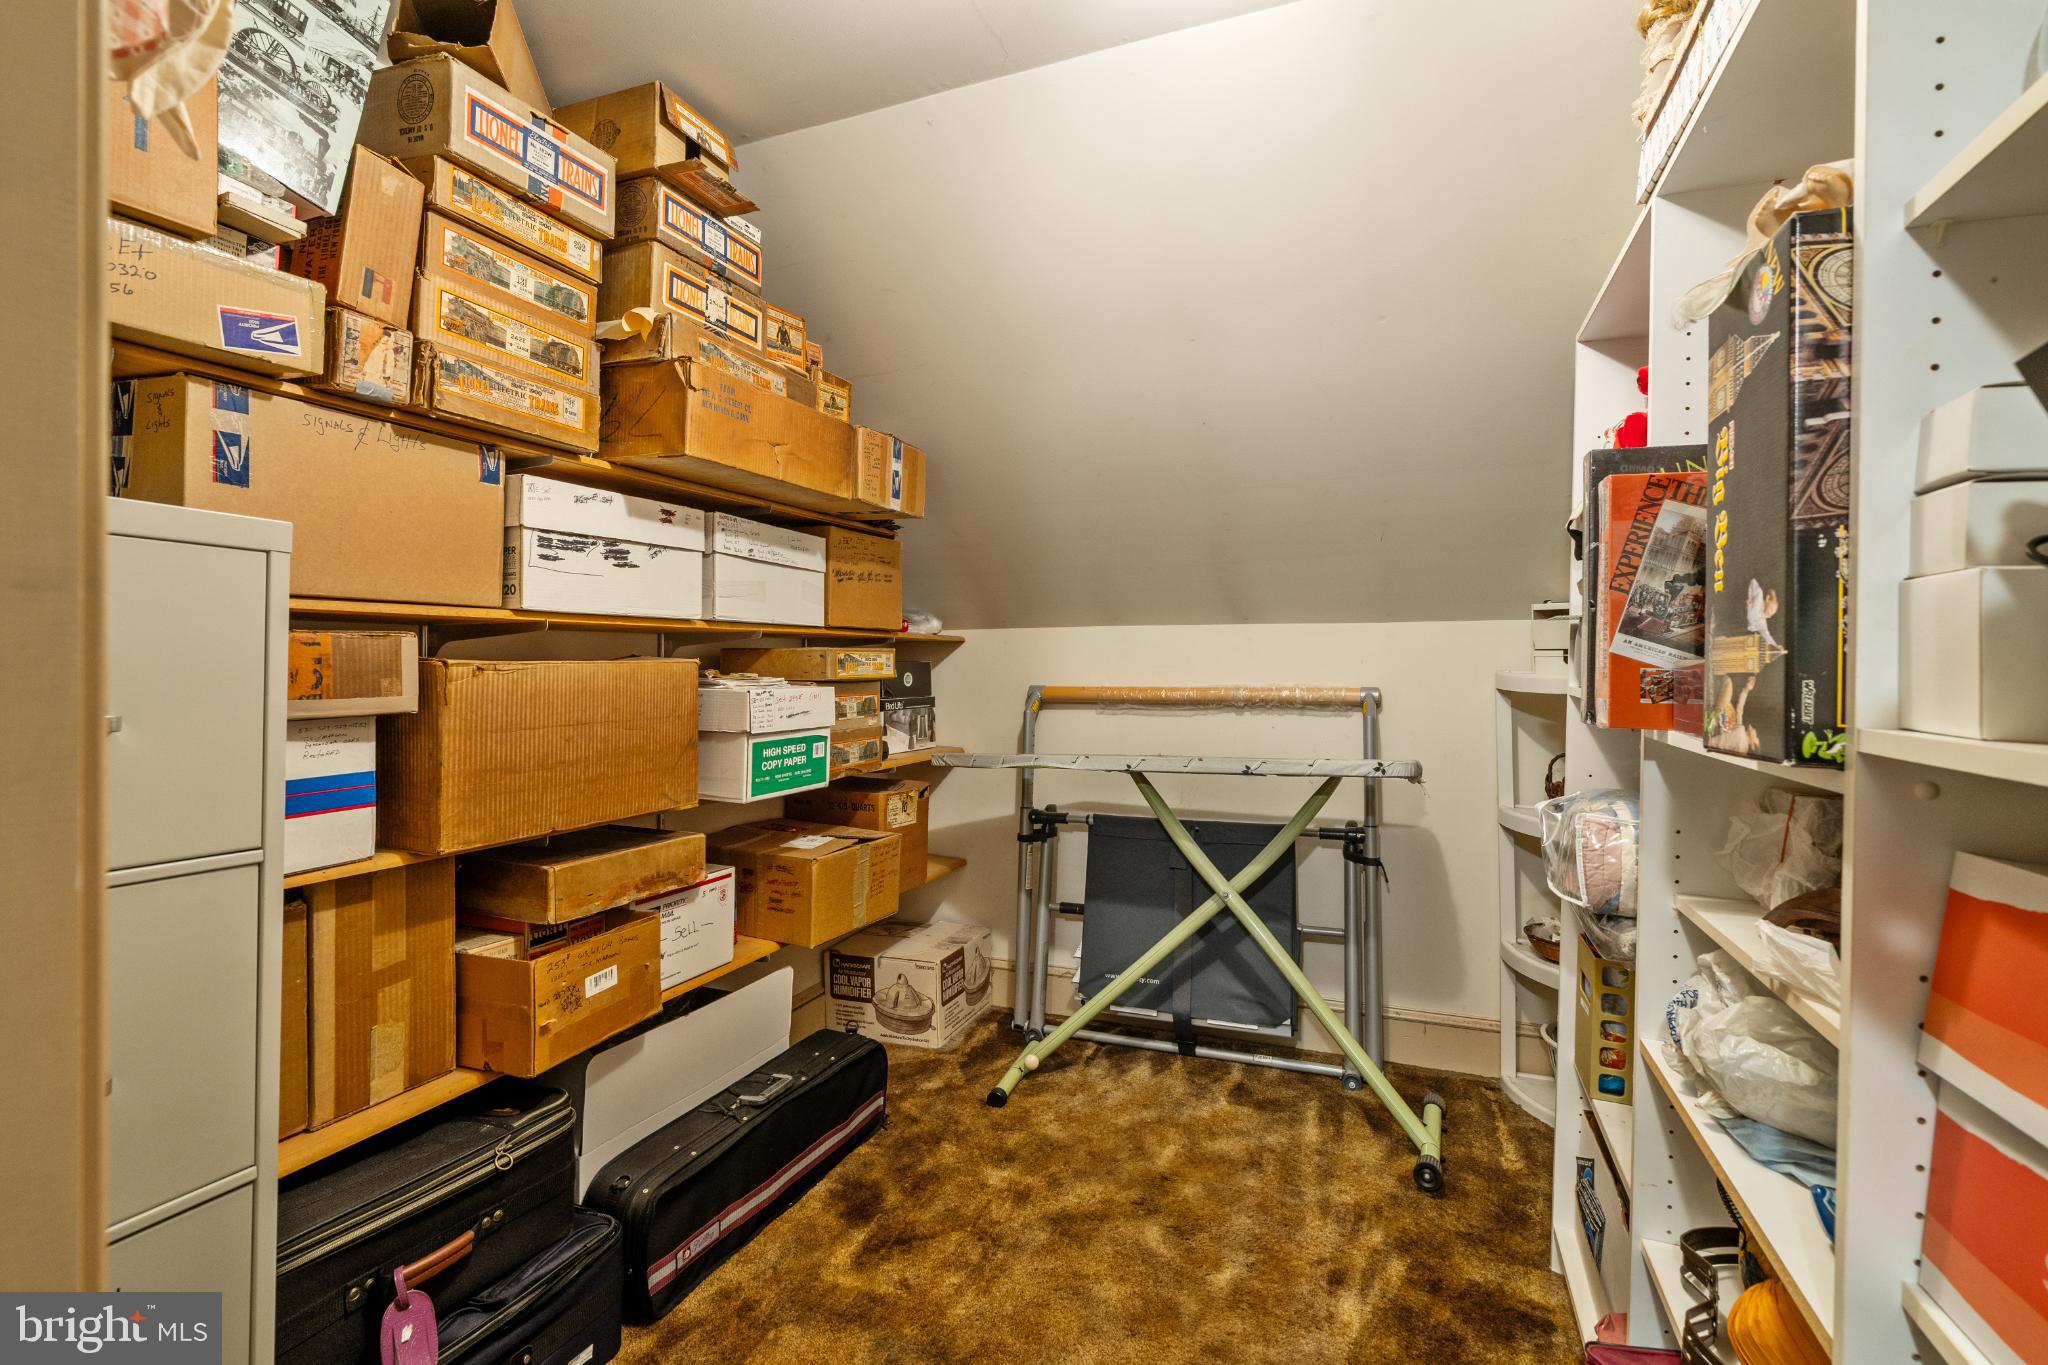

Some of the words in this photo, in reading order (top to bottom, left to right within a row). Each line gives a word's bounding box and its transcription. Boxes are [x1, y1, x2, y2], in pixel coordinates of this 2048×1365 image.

[479, 109, 521, 158] LIONEL
[561, 155, 599, 199] TRAINS
[671, 201, 702, 243] LIONEL
[729, 239, 757, 274] TRAINS
[675, 280, 705, 316] LIONEL
[458, 372, 493, 397] LIONEL
[529, 394, 560, 417] TRAINS
[1609, 474, 1672, 595] EXPERIENCE
[763, 746, 782, 759] HIGH
[783, 743, 807, 756] SPEED
[761, 759, 783, 772] COPY
[784, 755, 807, 768] PAPER
[662, 897, 687, 910] PRIORITY
[833, 974, 850, 985] COOL
[850, 975, 872, 988] VAPOR
[833, 984, 872, 999] HUMIDIFIER
